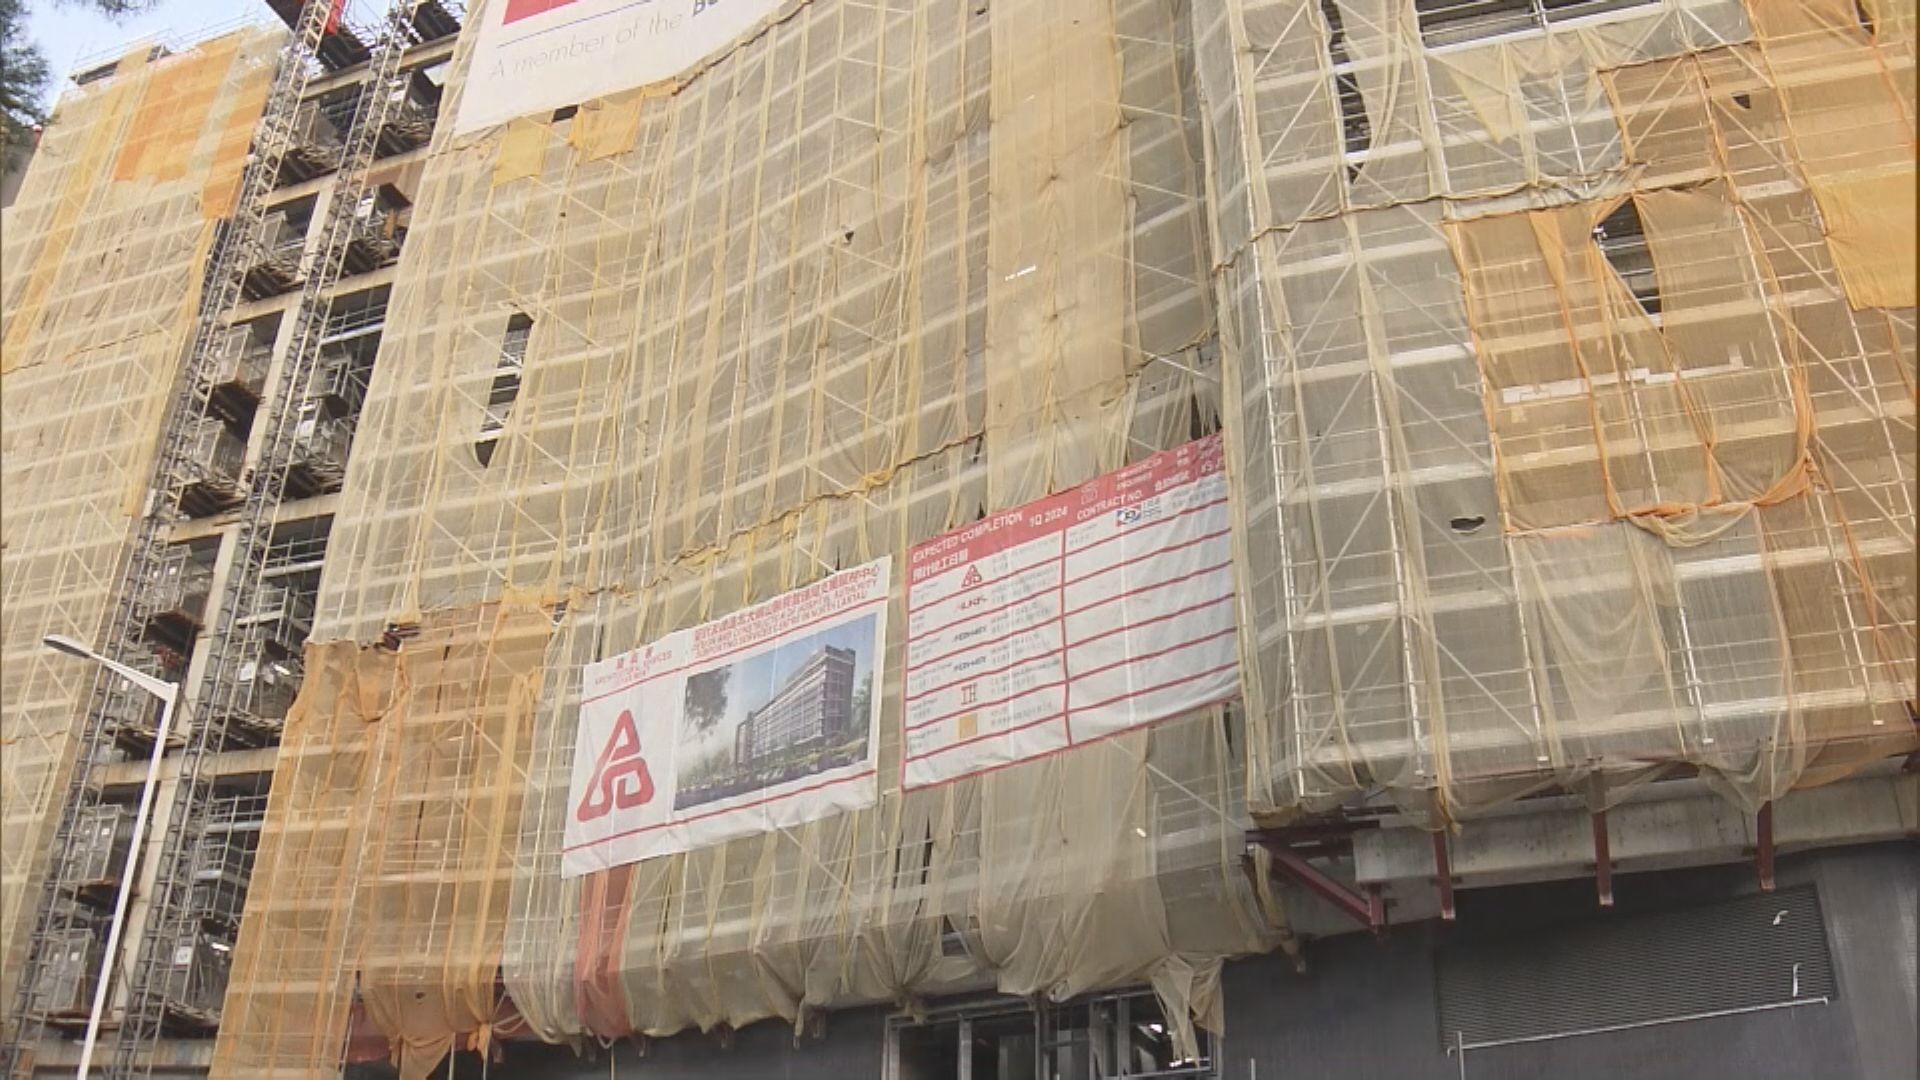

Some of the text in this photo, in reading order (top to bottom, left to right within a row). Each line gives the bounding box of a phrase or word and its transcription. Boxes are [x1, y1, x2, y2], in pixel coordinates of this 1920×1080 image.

[512, 33, 606, 74] member
[616, 23, 639, 45] of
[648, 11, 682, 35] the
[1044, 506, 1069, 524] 2024
[1076, 494, 1126, 520] CONTRACT
[1127, 489, 1143, 502] NO.
[912, 535, 959, 563] EXPECTED
[961, 511, 1023, 544] COMPLETION
